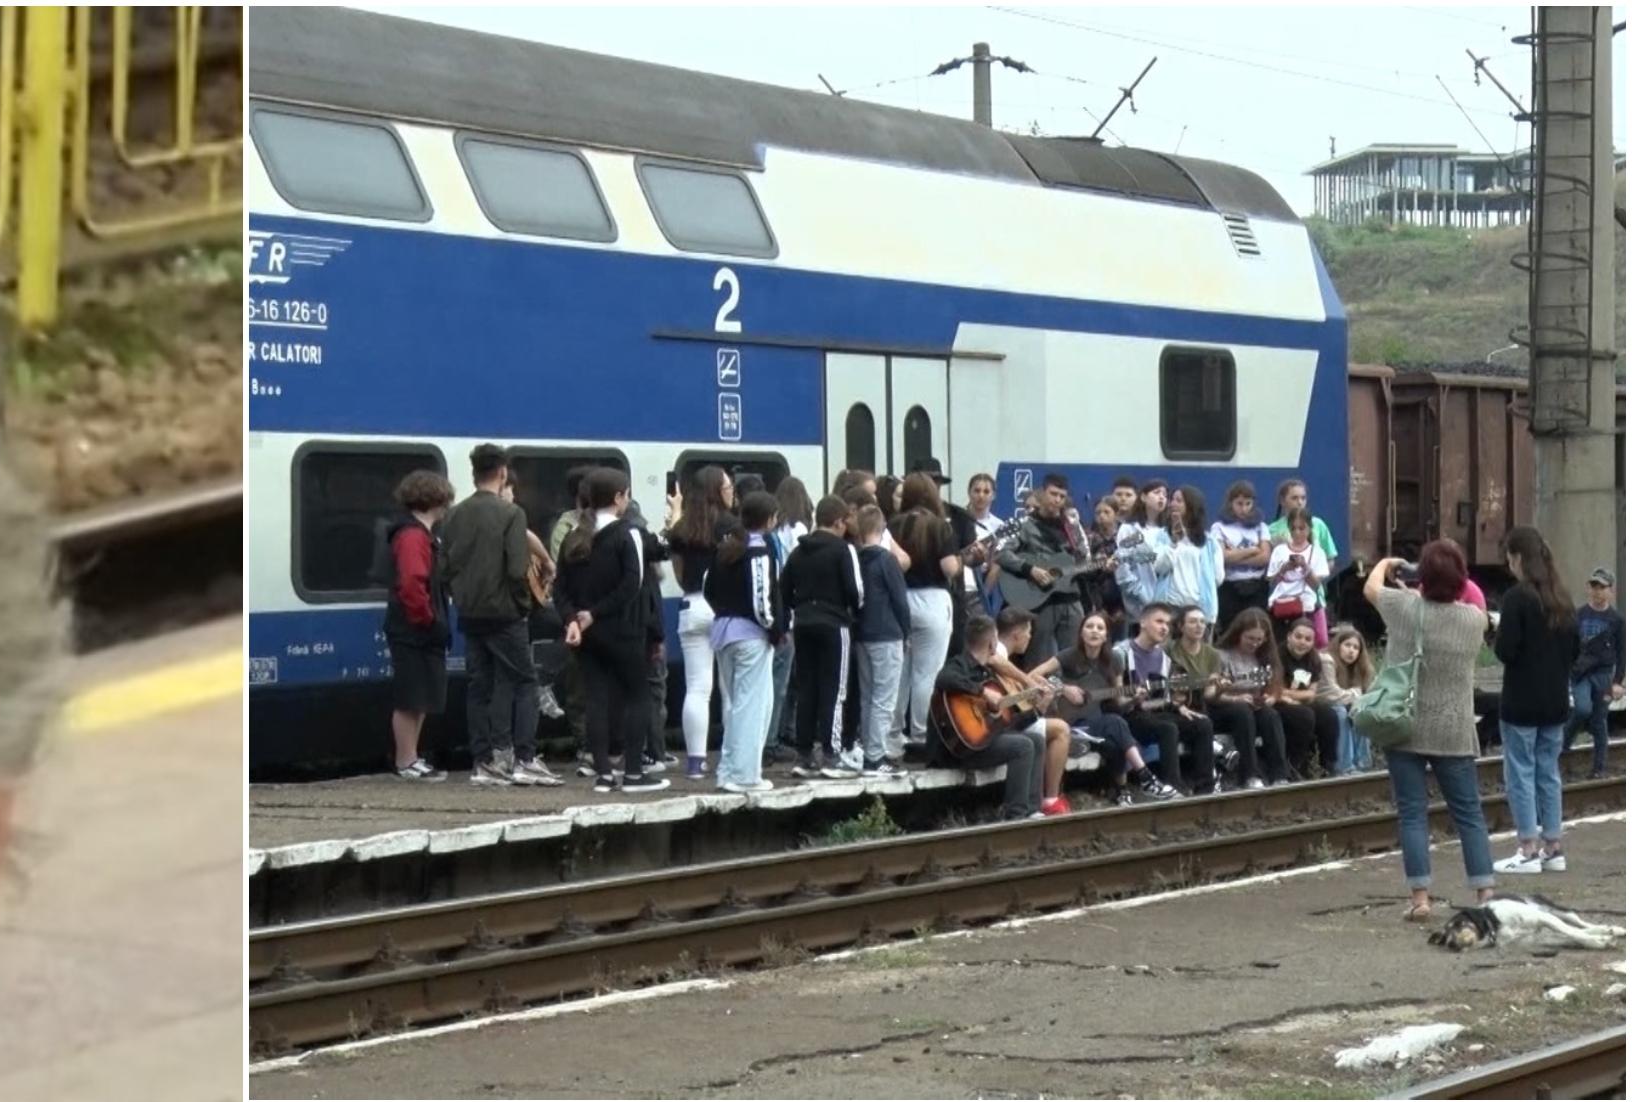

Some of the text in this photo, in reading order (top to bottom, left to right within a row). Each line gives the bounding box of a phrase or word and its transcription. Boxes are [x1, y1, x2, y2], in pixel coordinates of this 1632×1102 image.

[713, 267, 742, 333] 2
[283, 301, 327, 324] 126-0
[261, 342, 322, 365] CALATORI
